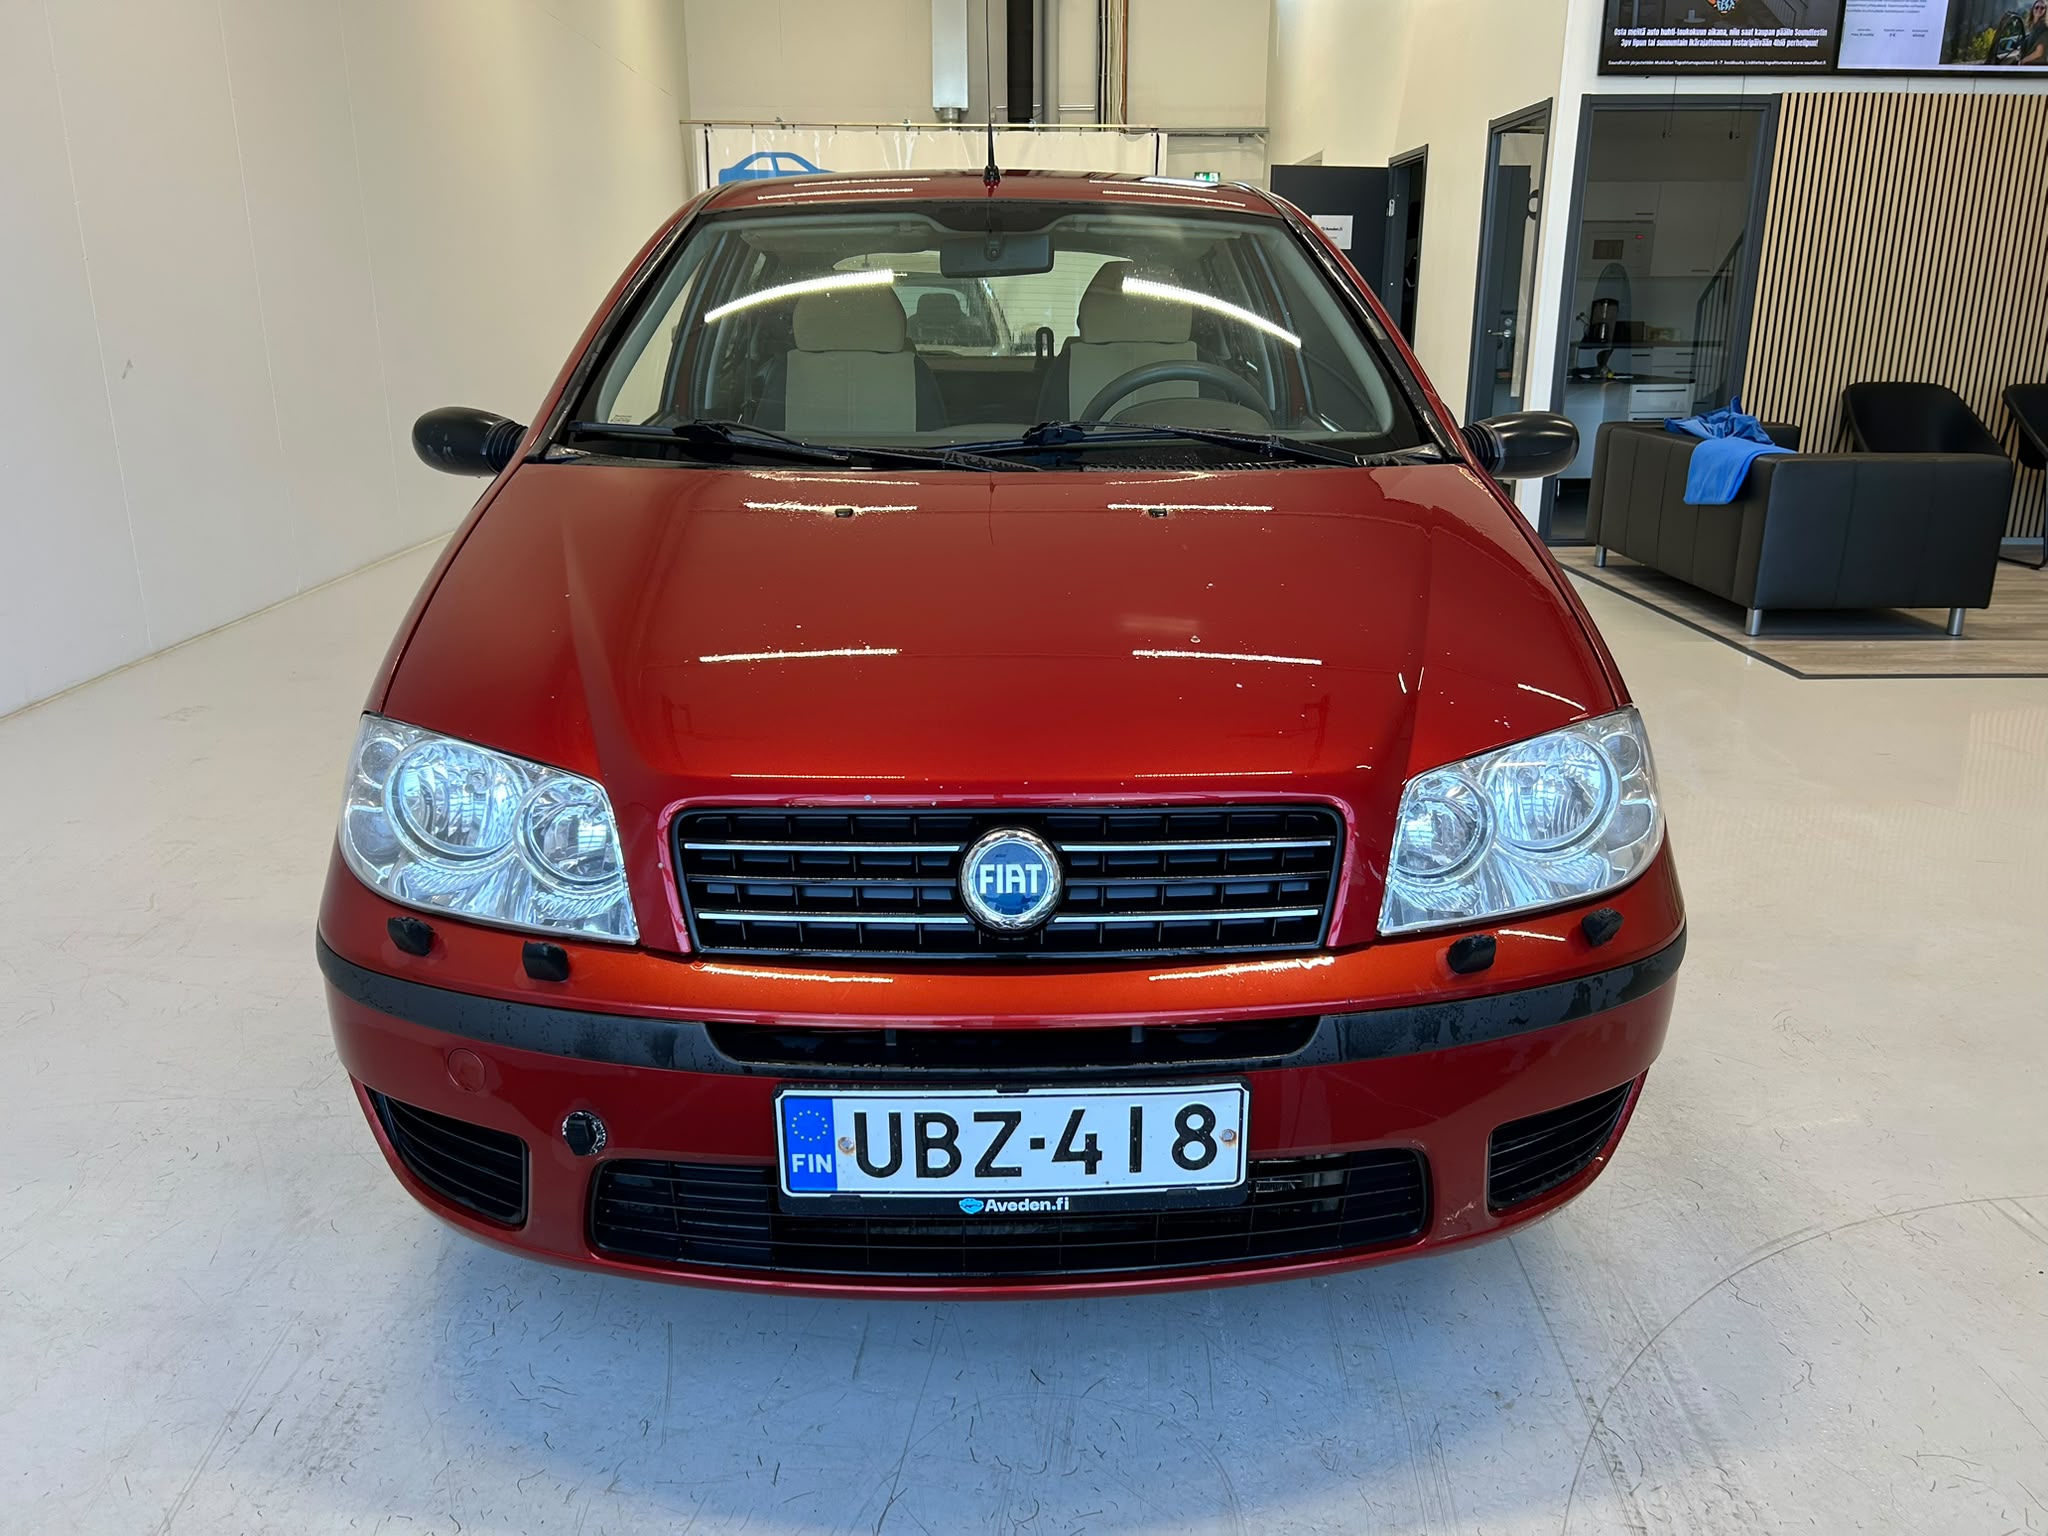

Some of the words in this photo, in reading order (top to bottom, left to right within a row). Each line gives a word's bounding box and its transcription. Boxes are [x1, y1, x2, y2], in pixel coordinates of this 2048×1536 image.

[979, 863, 1043, 894] FIAT
[854, 1103, 1218, 1178] UBZ-418
[791, 1153, 833, 1173] FIN
[984, 1196, 1070, 1213] Aveden.fi
